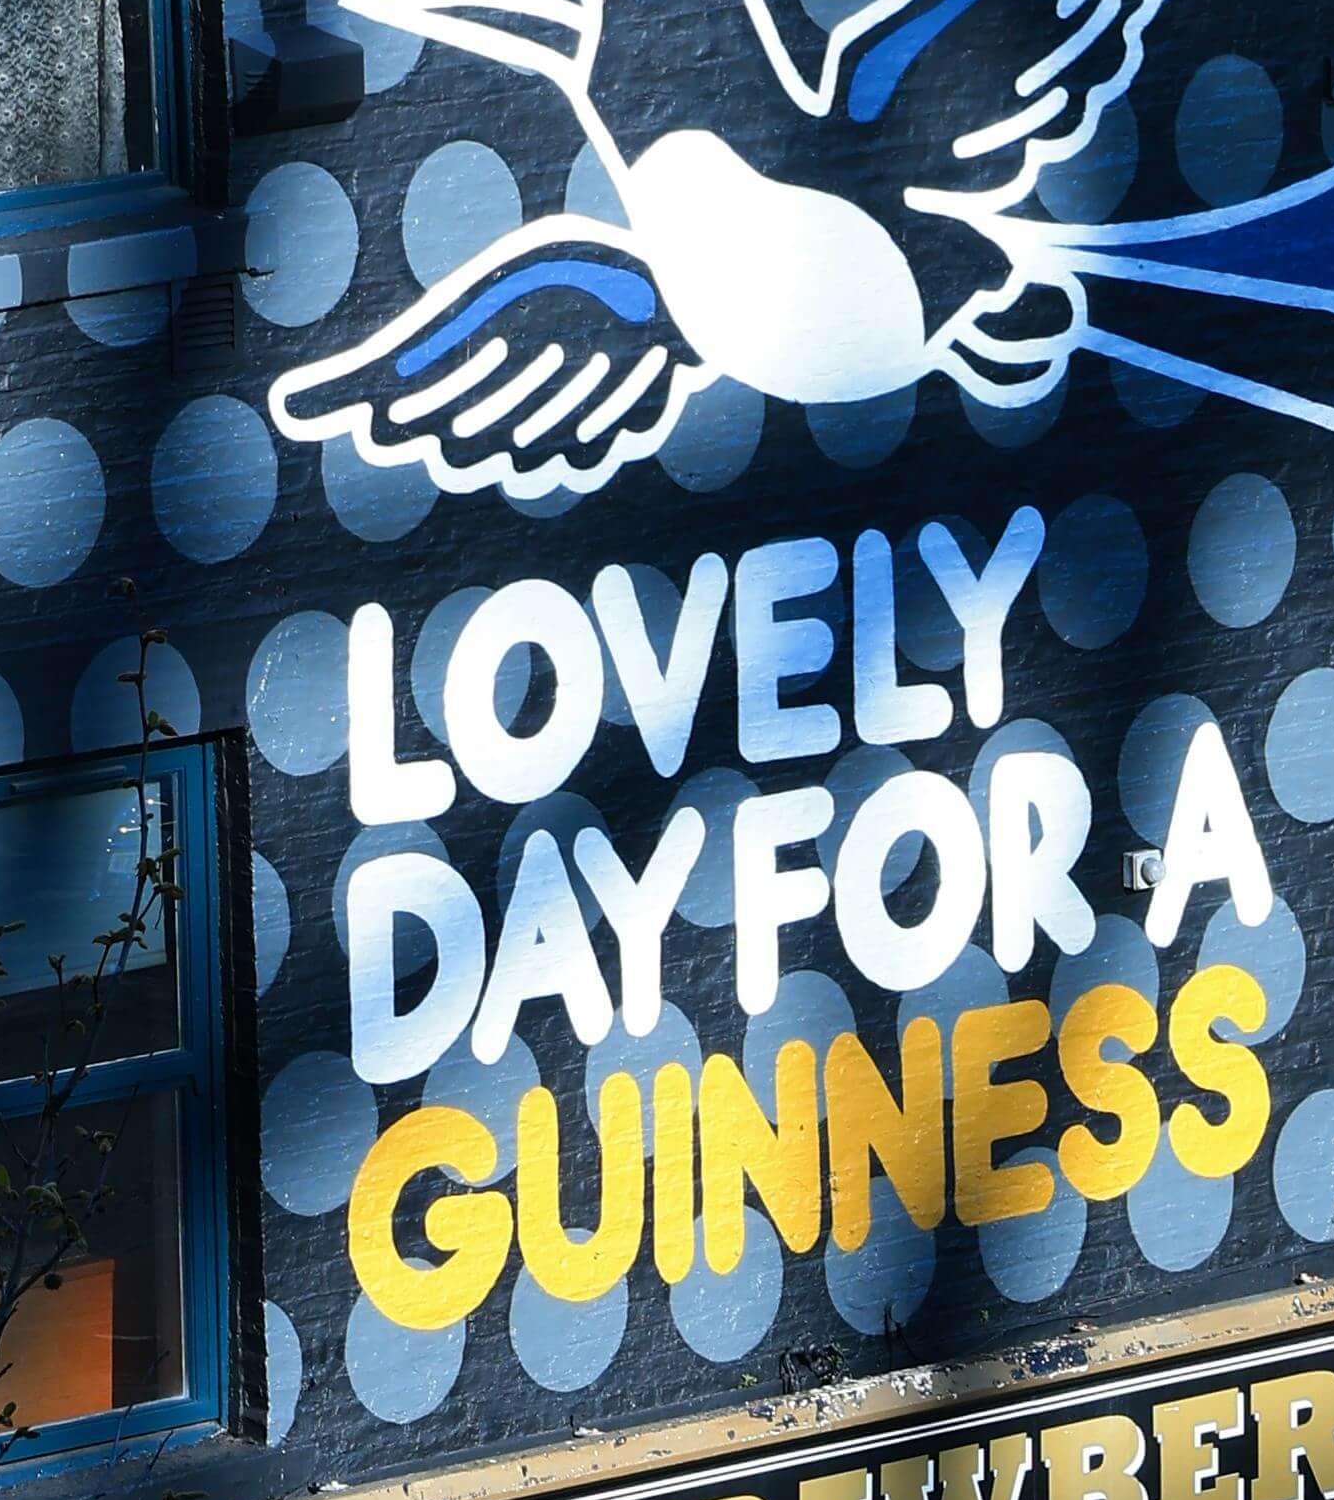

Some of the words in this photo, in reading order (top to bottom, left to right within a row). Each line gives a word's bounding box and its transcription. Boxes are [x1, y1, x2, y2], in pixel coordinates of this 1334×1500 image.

[347, 505, 1046, 825] LOVELY
[347, 806, 704, 1085] DAY
[736, 751, 1096, 1016] FOR
[1145, 722, 1272, 947] A
[347, 964, 1271, 1331] GUINNESS
